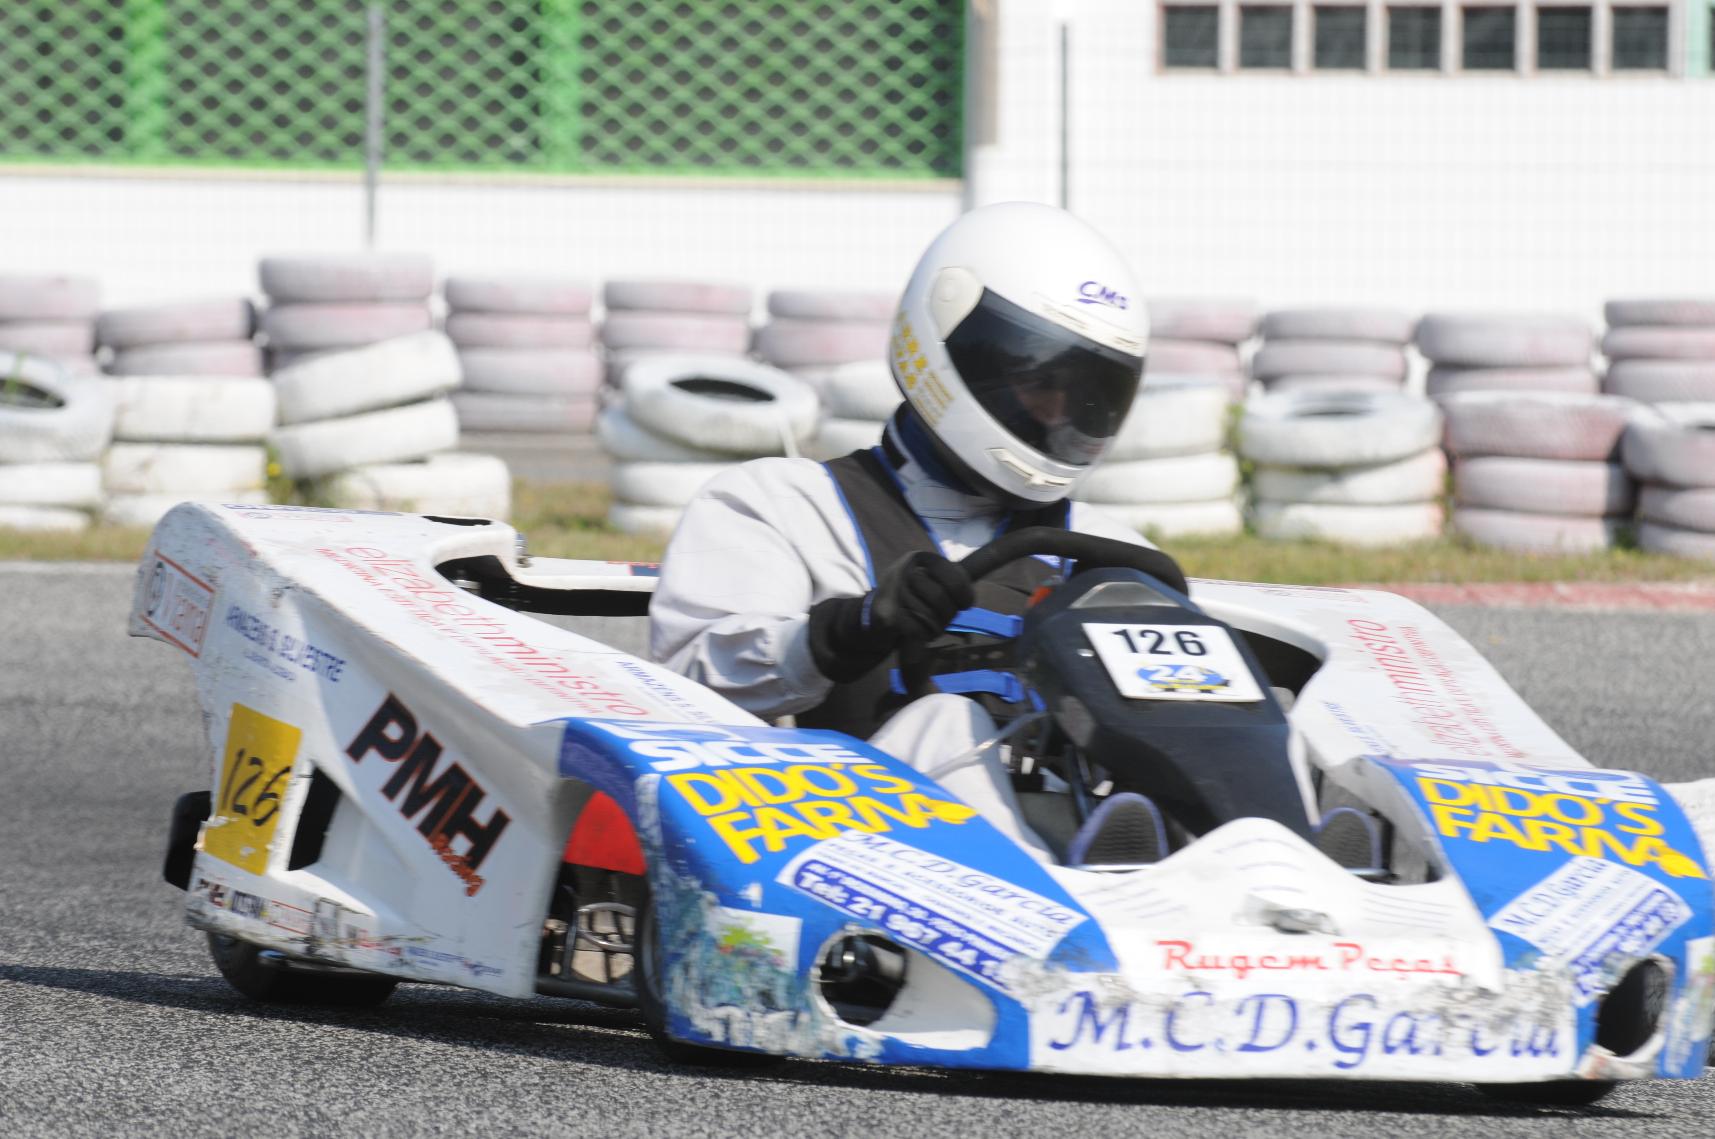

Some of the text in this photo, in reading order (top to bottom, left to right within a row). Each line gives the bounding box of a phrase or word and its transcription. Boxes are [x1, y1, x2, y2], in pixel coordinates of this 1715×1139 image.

[1111, 628, 1208, 657] 126
[221, 747, 292, 827] 126
[346, 691, 513, 872] PMH
[665, 762, 918, 818] DIDO'S
[1415, 776, 1666, 836] DIDO'S
[846, 896, 887, 920] 21
